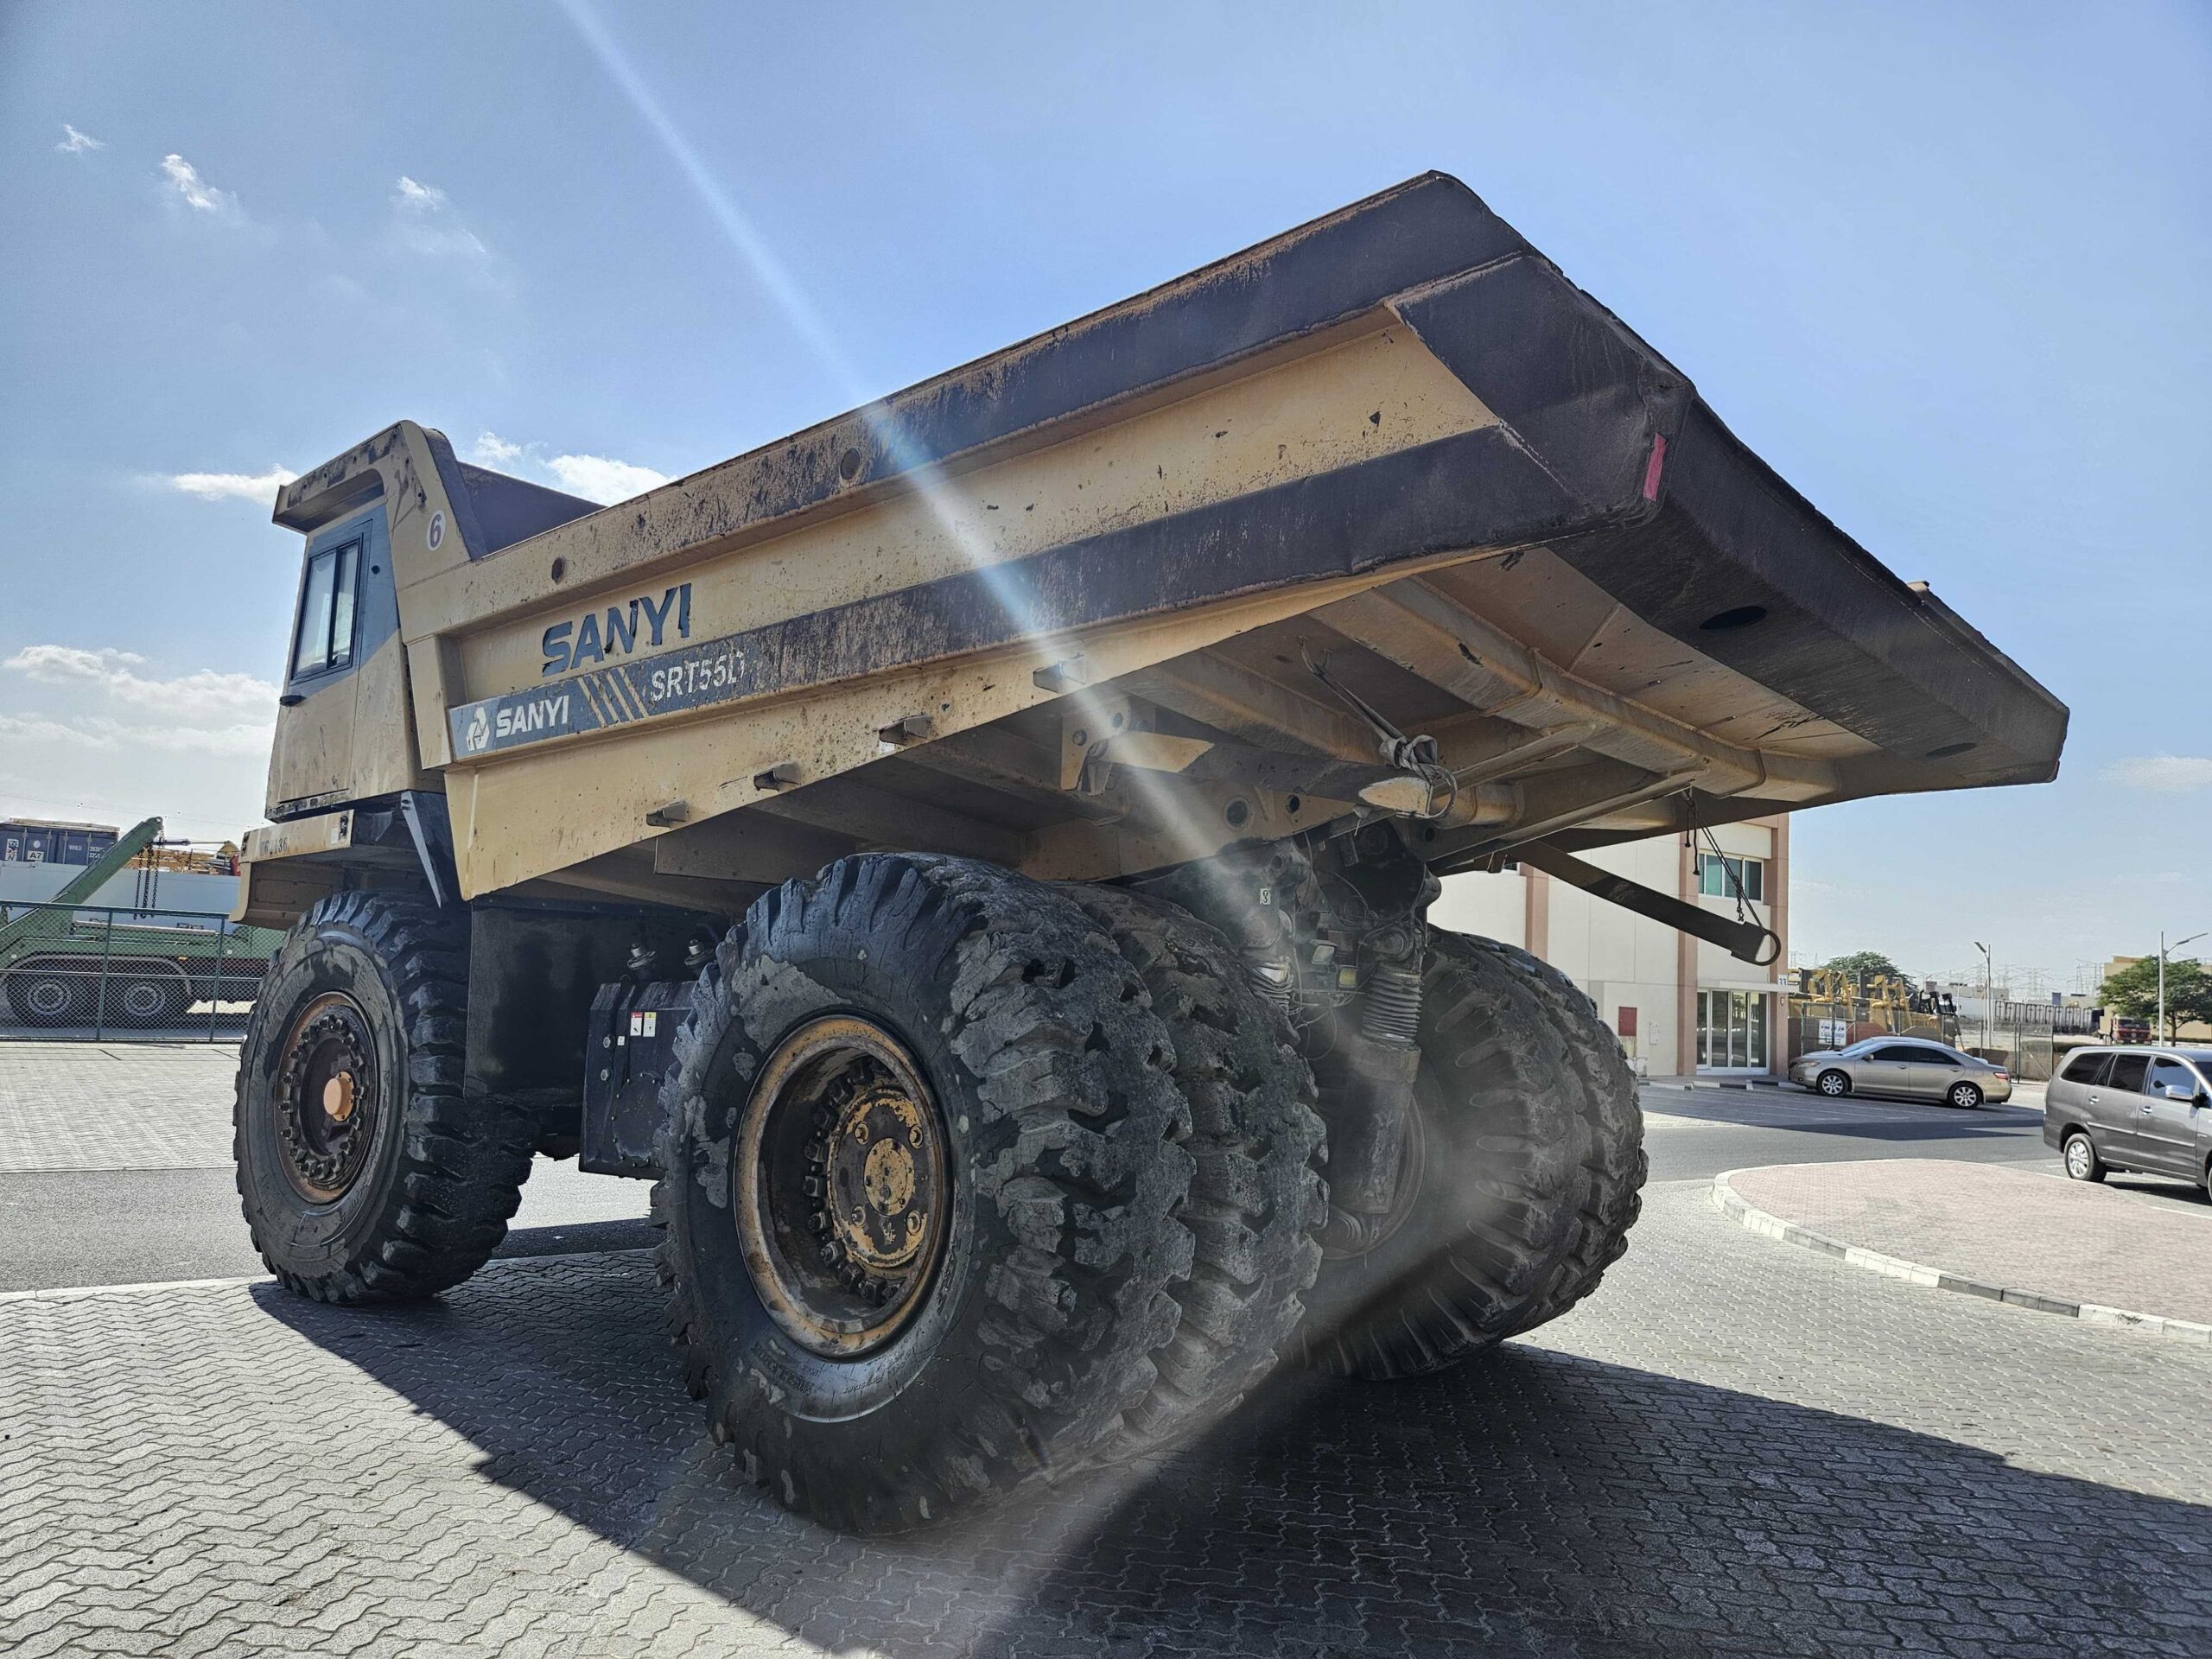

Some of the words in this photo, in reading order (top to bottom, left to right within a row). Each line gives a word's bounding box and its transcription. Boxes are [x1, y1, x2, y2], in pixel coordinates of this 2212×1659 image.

[429, 513, 443, 548] 6
[542, 582, 692, 678] SANYI
[495, 694, 570, 739] SANYI
